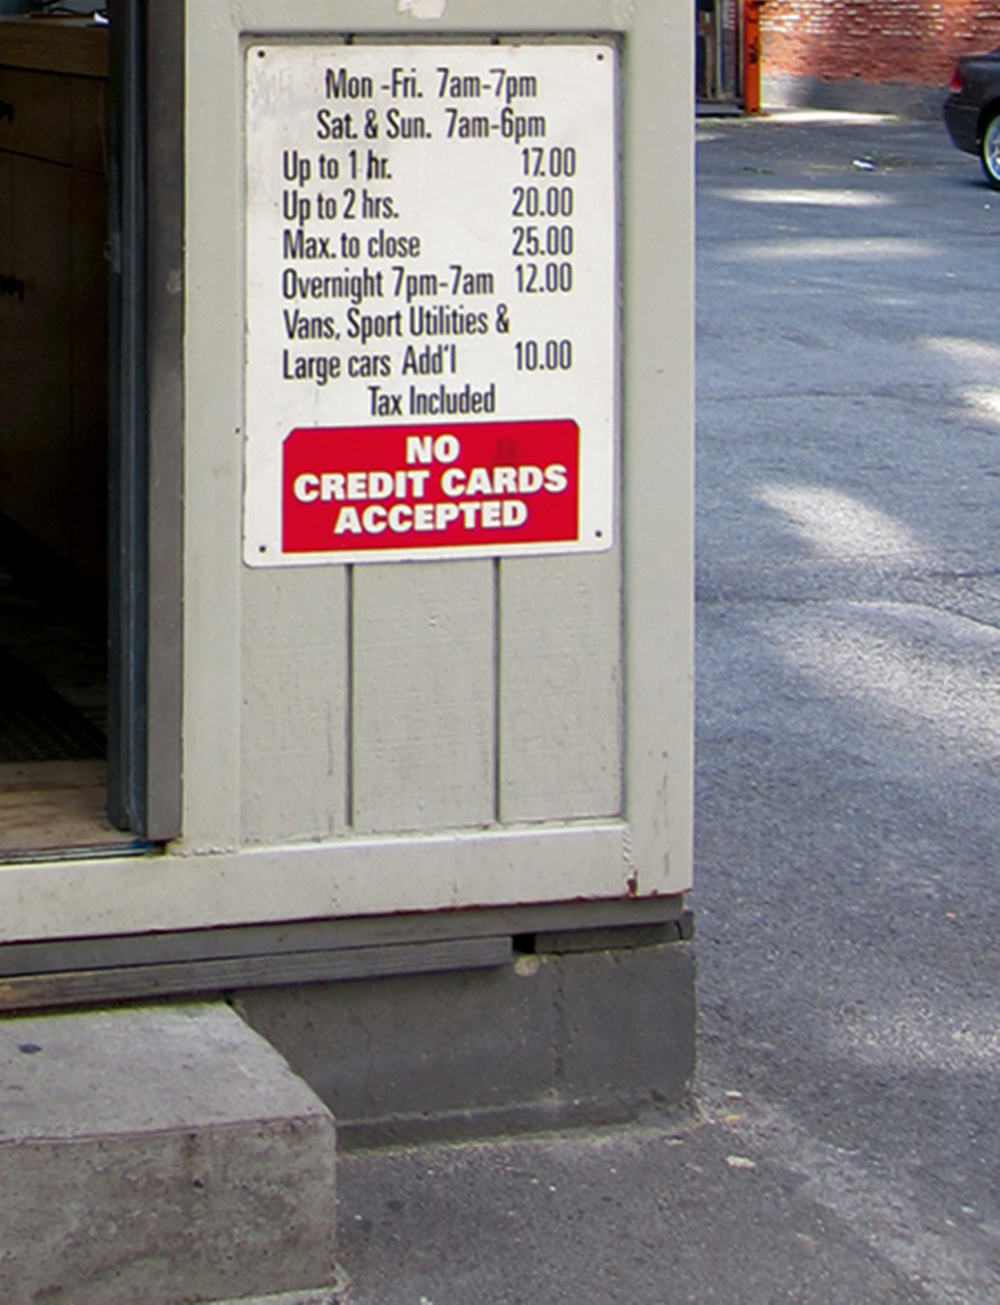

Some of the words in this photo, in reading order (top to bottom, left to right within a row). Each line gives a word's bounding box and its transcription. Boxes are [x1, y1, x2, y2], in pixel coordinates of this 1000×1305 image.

[325, 68, 373, 99] Mon
[436, 67, 537, 104] 7am-7pm
[317, 108, 358, 140] Sat.
[364, 108, 378, 139] &
[386, 108, 432, 139] Sun.
[445, 107, 546, 145] 7am-6pm
[283, 149, 311, 187] Up
[319, 154, 339, 179] to
[349, 149, 357, 179] 1
[366, 149, 392, 181] hr.
[521, 147, 576, 177] 17.00
[283, 189, 311, 227] Up
[317, 193, 337, 219] to
[343, 188, 356, 219] 2
[362, 188, 399, 219] hrs.
[512, 186, 574, 217] 20.00
[283, 229, 336, 259] Max.
[340, 232, 360, 259] to
[368, 228, 420, 258] close
[512, 225, 573, 256] 25.00
[282, 266, 384, 305] Overnight
[392, 264, 494, 304] 7pm-7am
[515, 262, 573, 293] 12.00
[283, 308, 341, 340] Vans,
[347, 306, 402, 345] Sport
[410, 304, 488, 336] Utilities
[495, 303, 509, 334] &
[283, 348, 341, 386] Large
[348, 354, 391, 378] cars
[402, 344, 456, 375] Add'l
[515, 339, 573, 371] 10.00
[367, 385, 402, 416] Tax
[410, 382, 495, 415] Included
[406, 434, 460, 464] NO
[294, 469, 430, 502] CREDIT
[441, 464, 568, 497] CARDS
[333, 499, 528, 535] ACCEPTED
